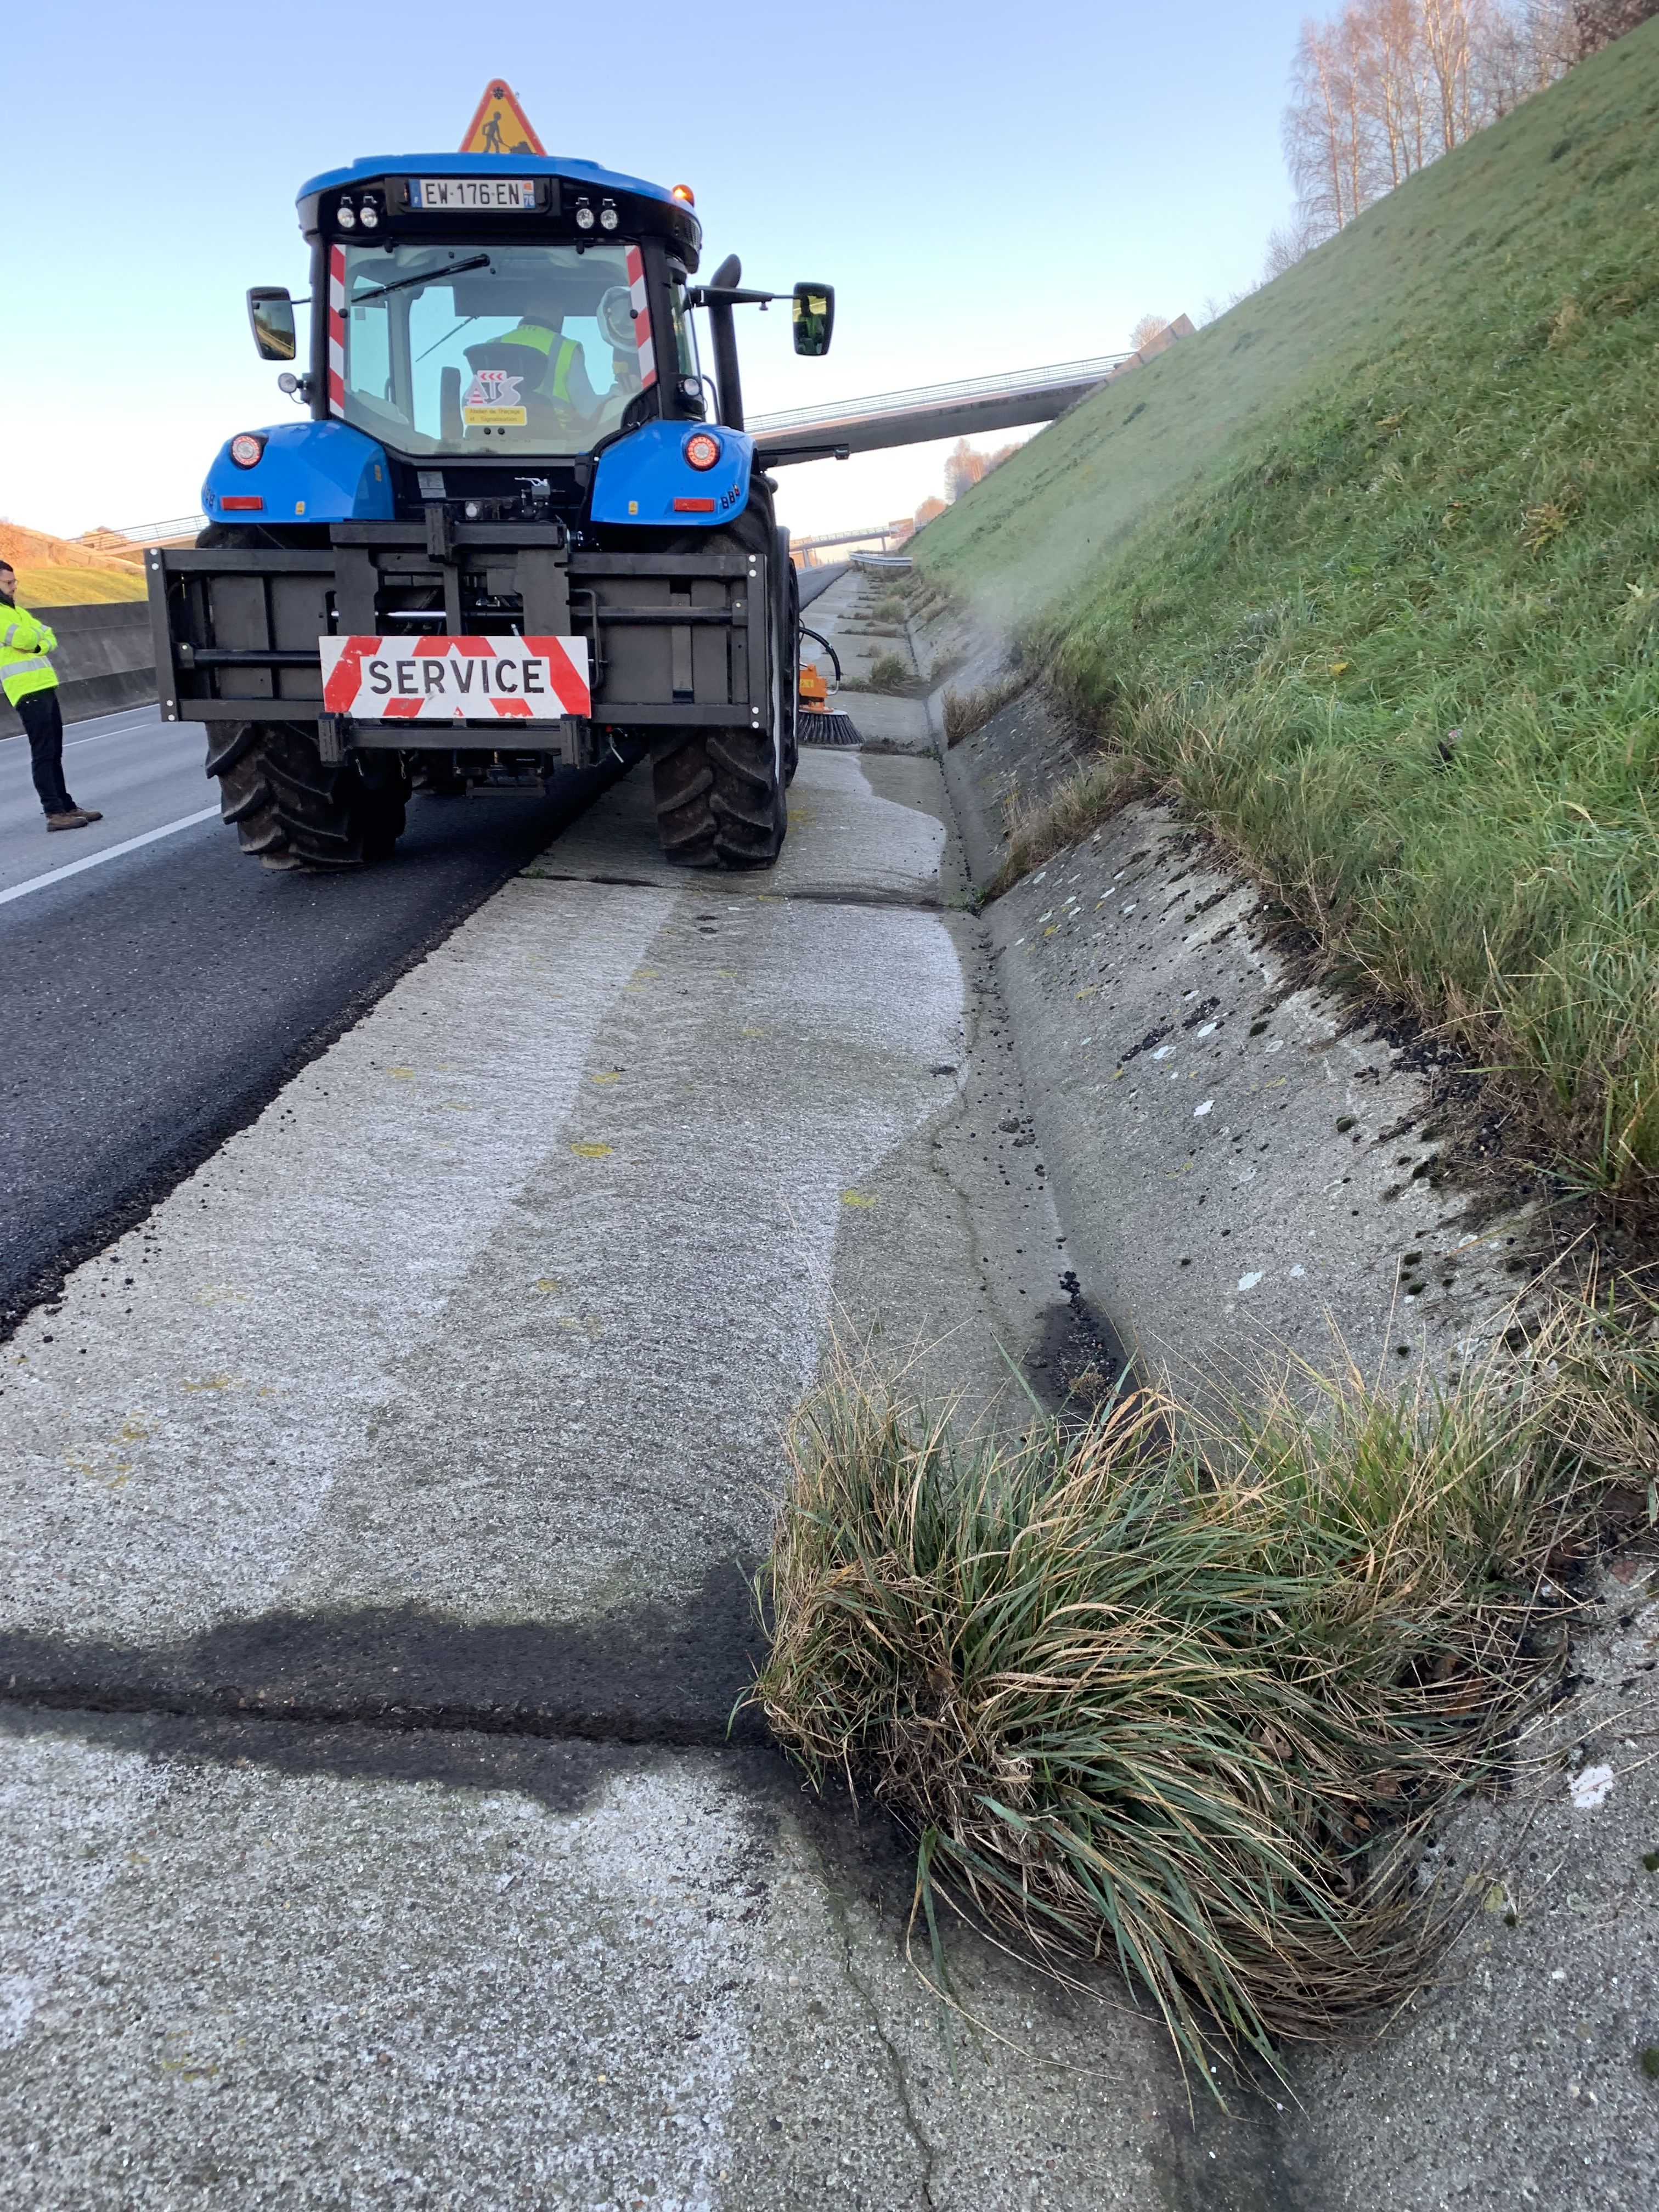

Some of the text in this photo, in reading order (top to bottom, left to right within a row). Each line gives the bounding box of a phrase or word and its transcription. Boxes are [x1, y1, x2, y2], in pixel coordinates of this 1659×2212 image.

[425, 183, 520, 205] EW-176-EN
[523, 195, 535, 206] 76
[368, 659, 544, 694] SERVICE
